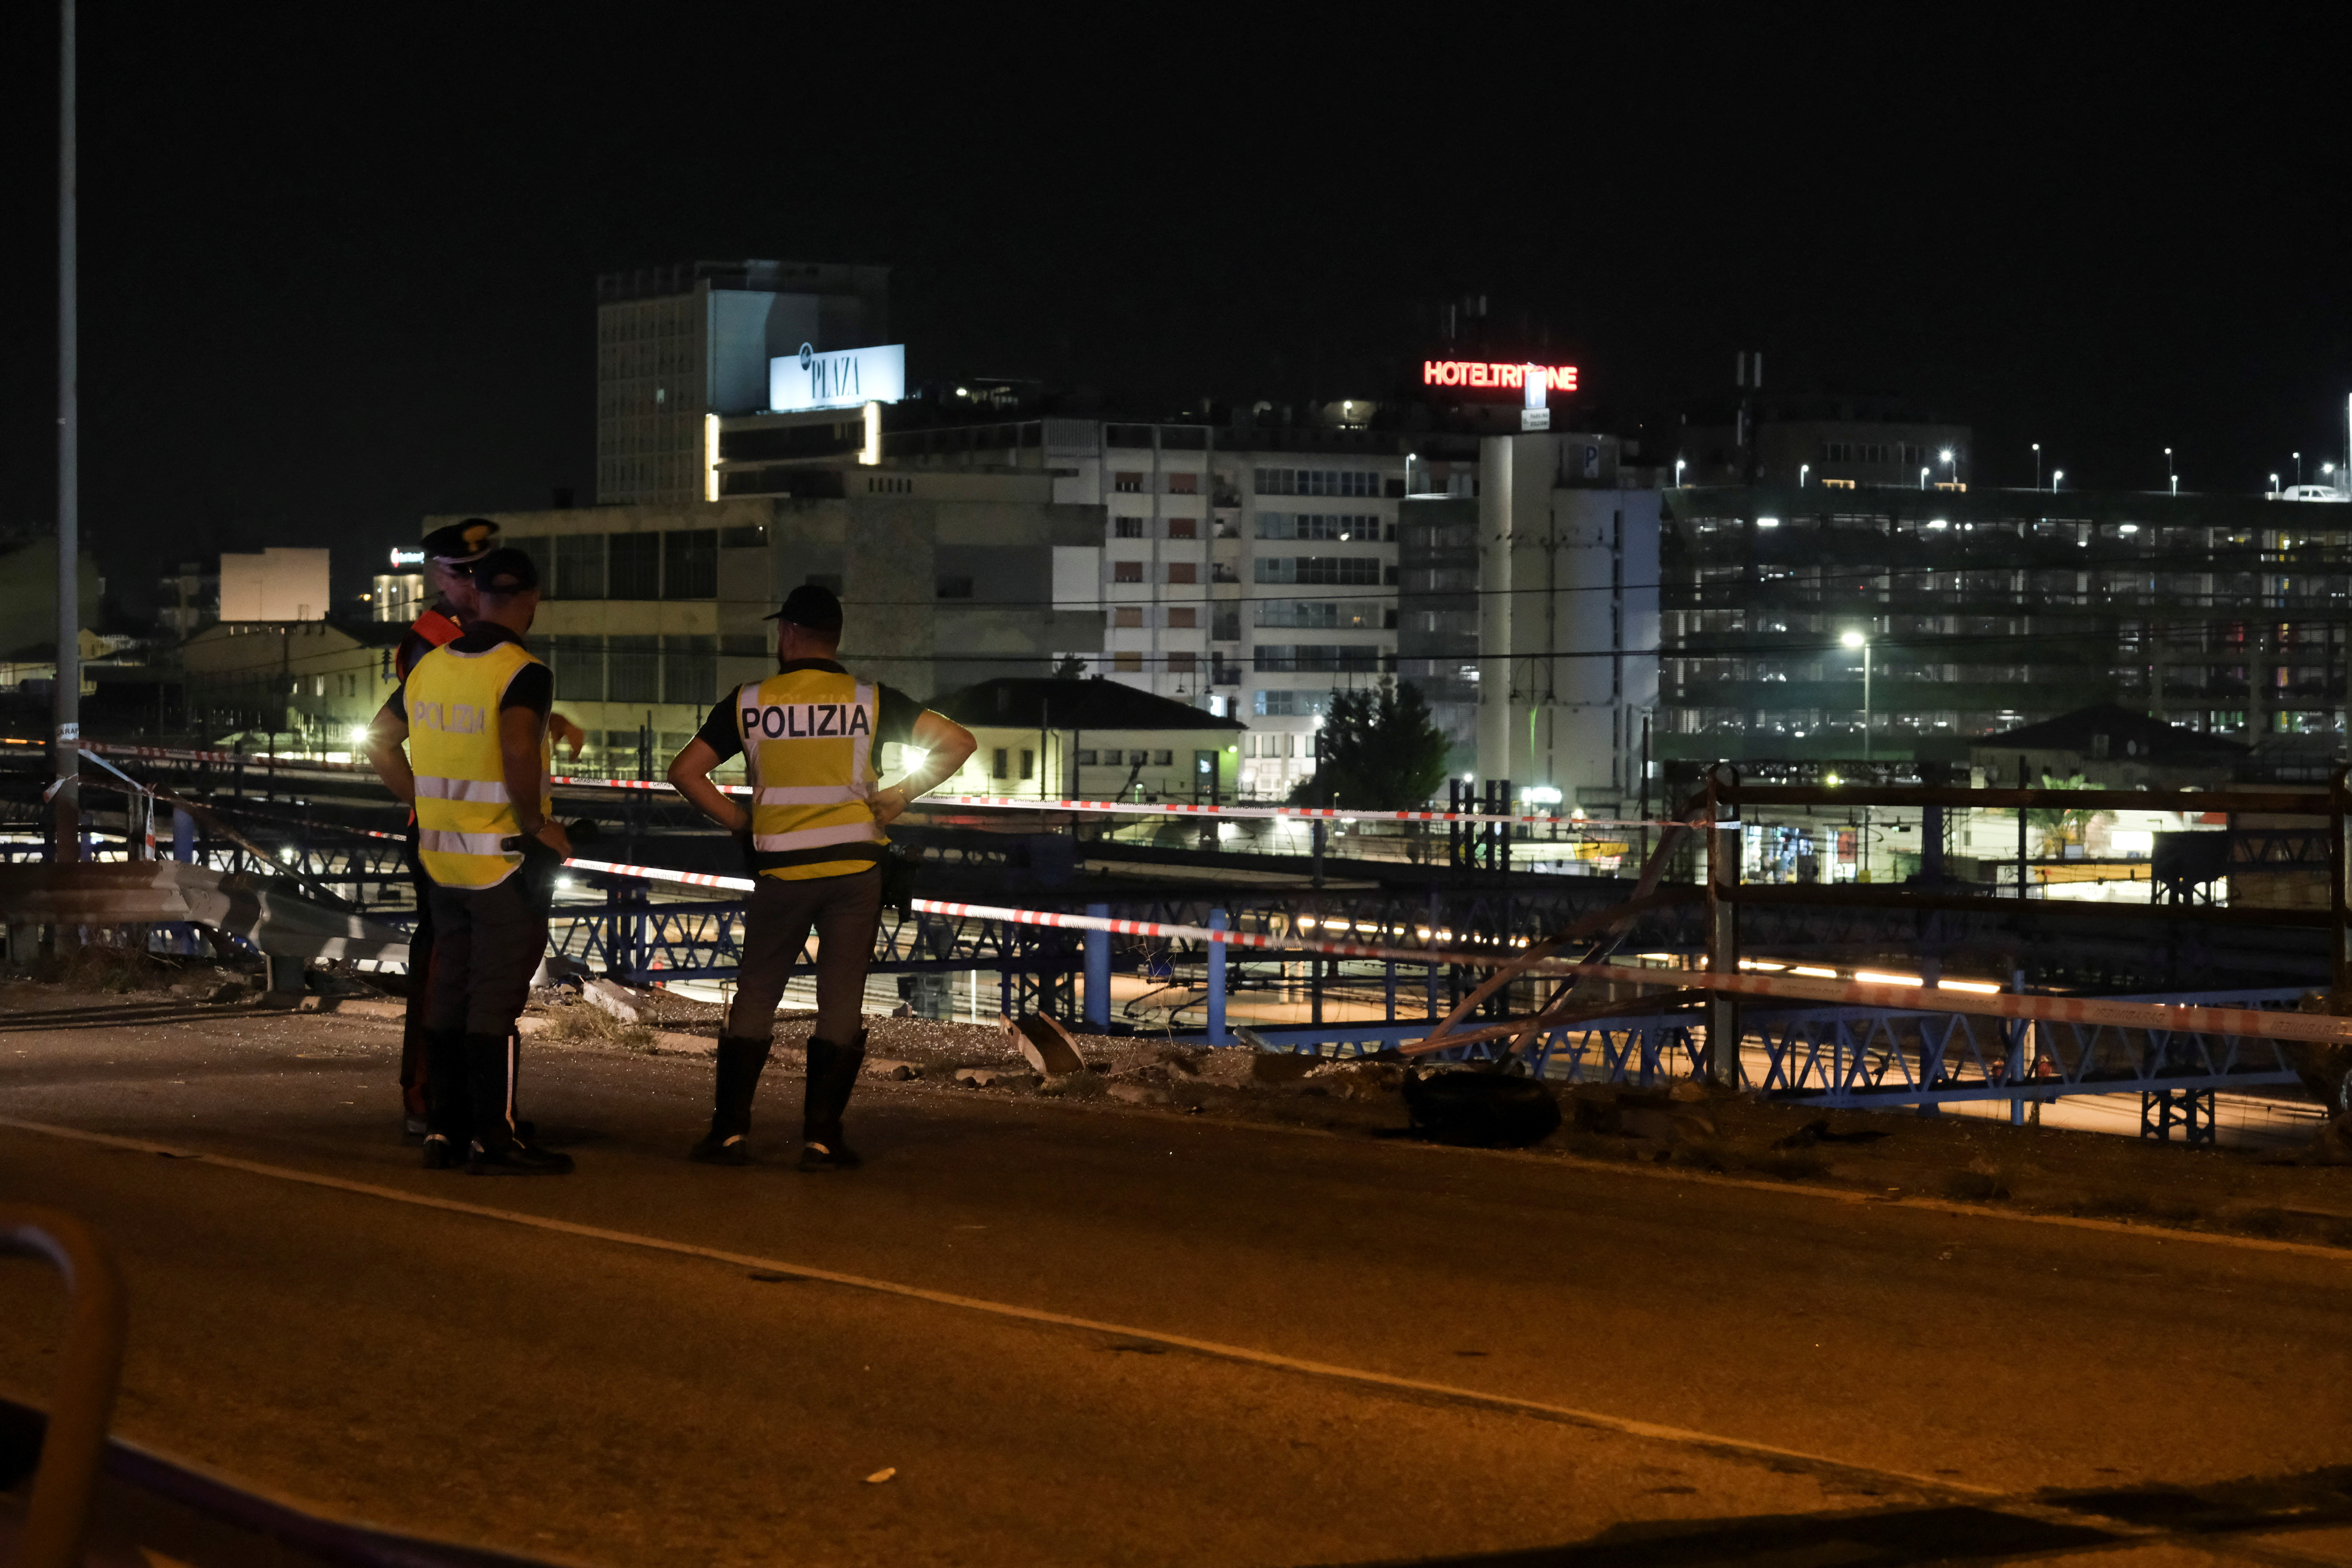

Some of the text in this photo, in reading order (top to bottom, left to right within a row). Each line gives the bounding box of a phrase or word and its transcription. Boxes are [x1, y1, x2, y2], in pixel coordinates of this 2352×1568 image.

[812, 356, 859, 399] PLAZA
[414, 701, 485, 734] POLIZIA
[742, 704, 870, 739] POLIZIA
